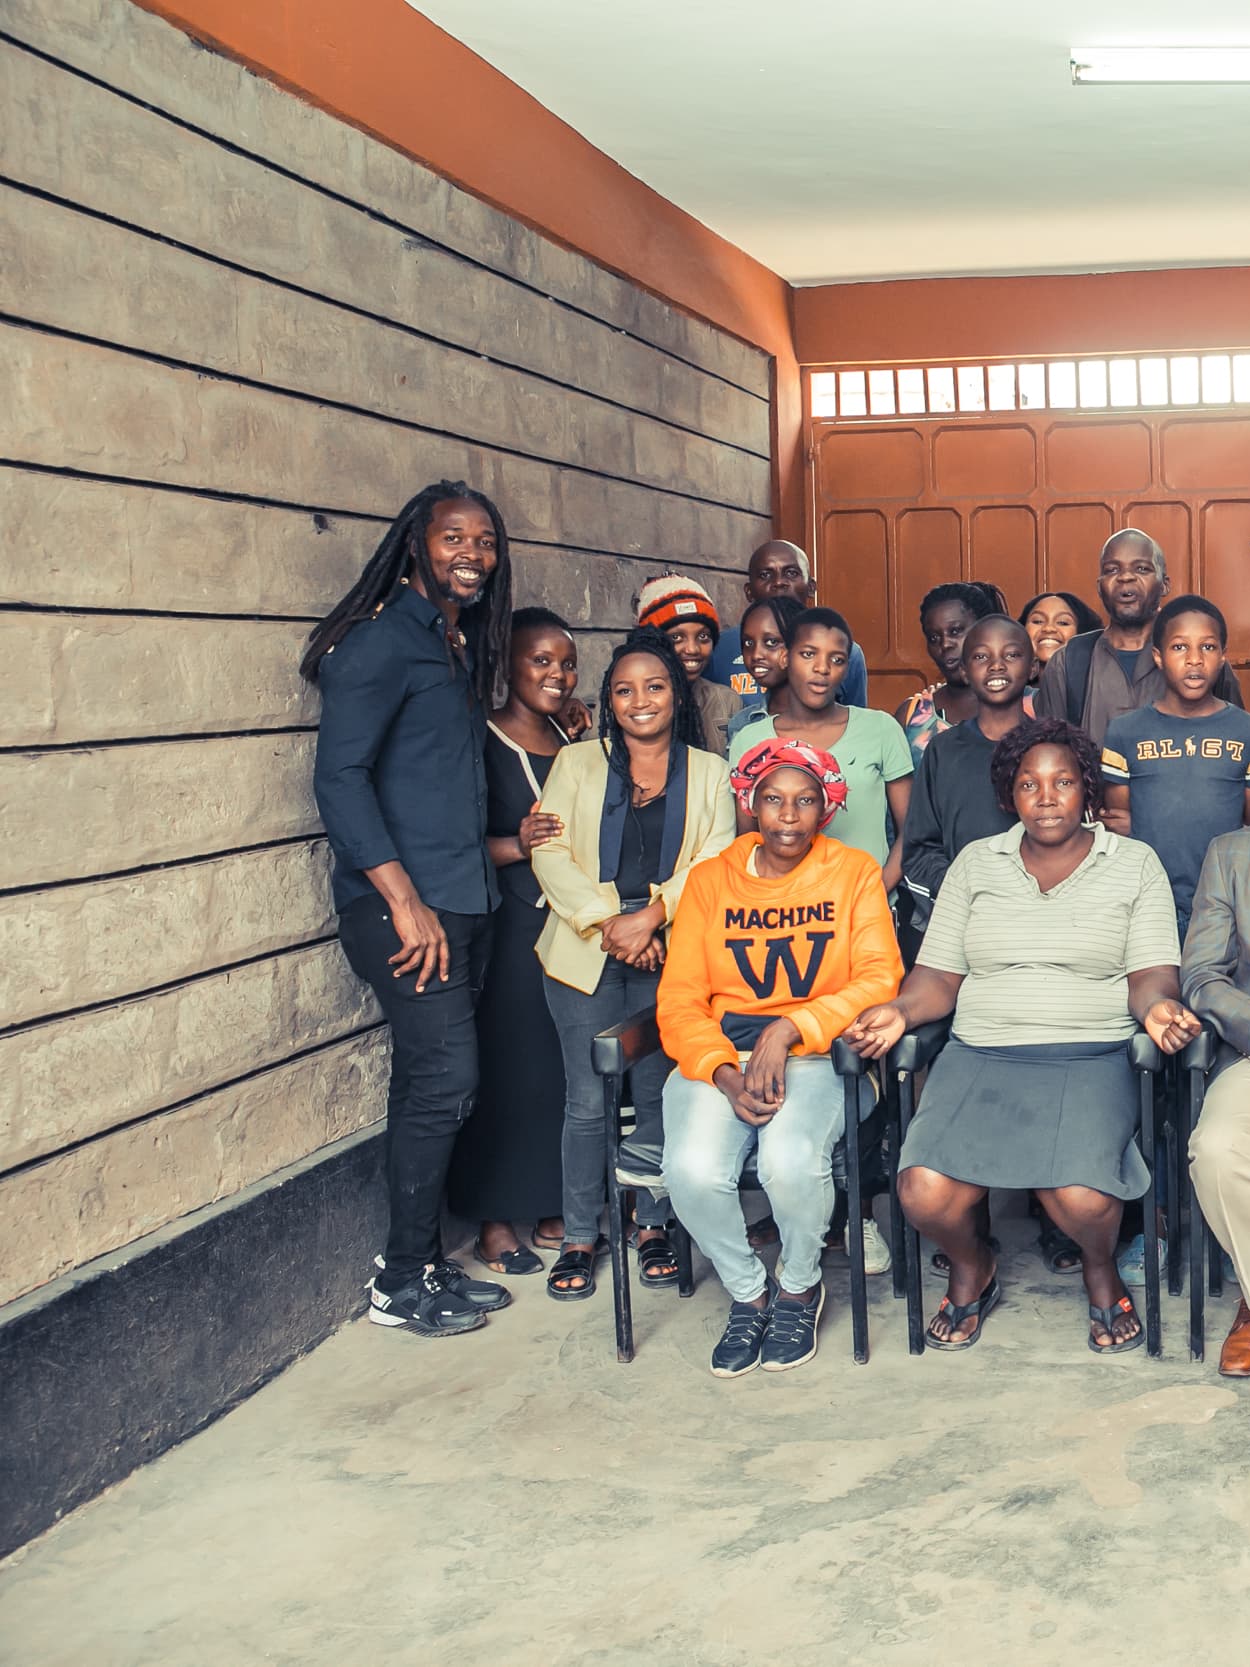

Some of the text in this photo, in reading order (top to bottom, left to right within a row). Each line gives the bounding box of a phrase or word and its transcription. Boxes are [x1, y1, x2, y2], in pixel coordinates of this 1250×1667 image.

[730, 672, 768, 694] NE
[1137, 739, 1182, 760] RL
[724, 901, 835, 930] MACHINE
[725, 931, 834, 1000] W
